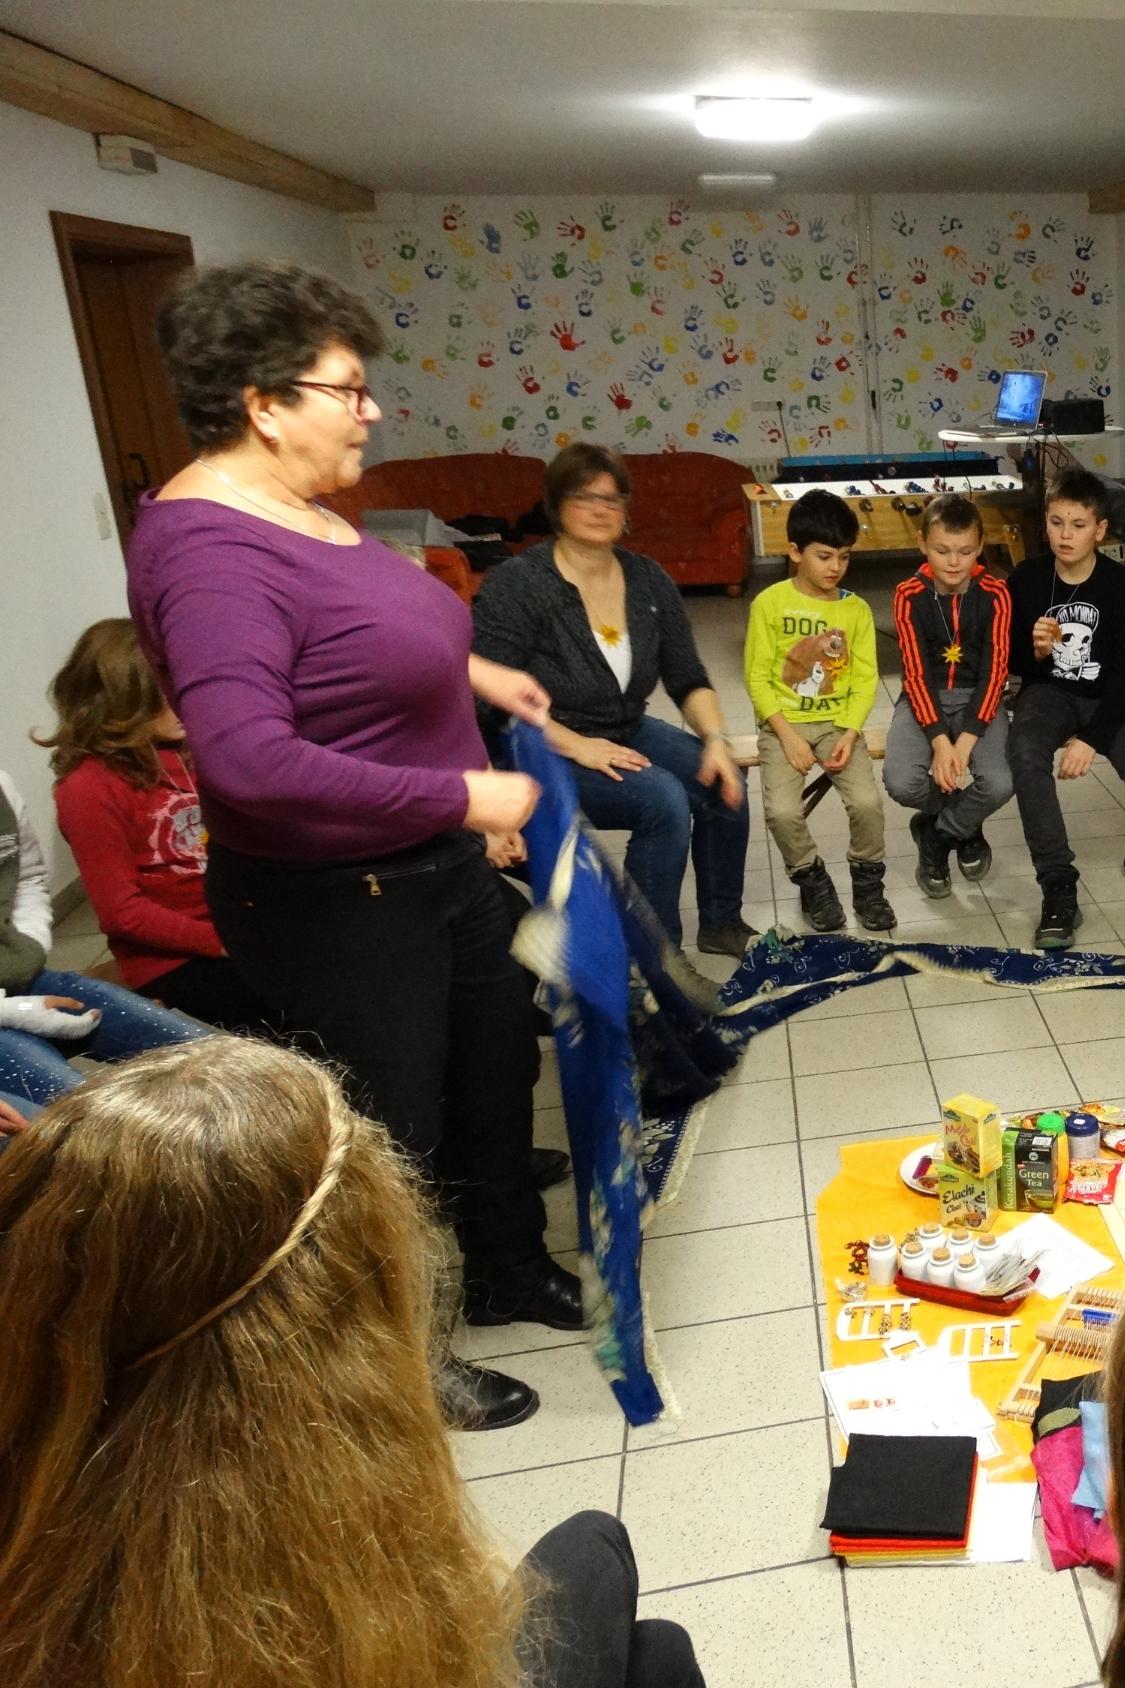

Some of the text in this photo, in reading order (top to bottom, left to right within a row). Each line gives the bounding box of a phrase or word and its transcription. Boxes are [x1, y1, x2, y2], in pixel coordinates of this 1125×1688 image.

[783, 617, 828, 635] DOG
[1019, 1168, 1050, 1180] Green
[1027, 1179, 1043, 1188] Tea
[943, 1184, 976, 1204] Elachi
